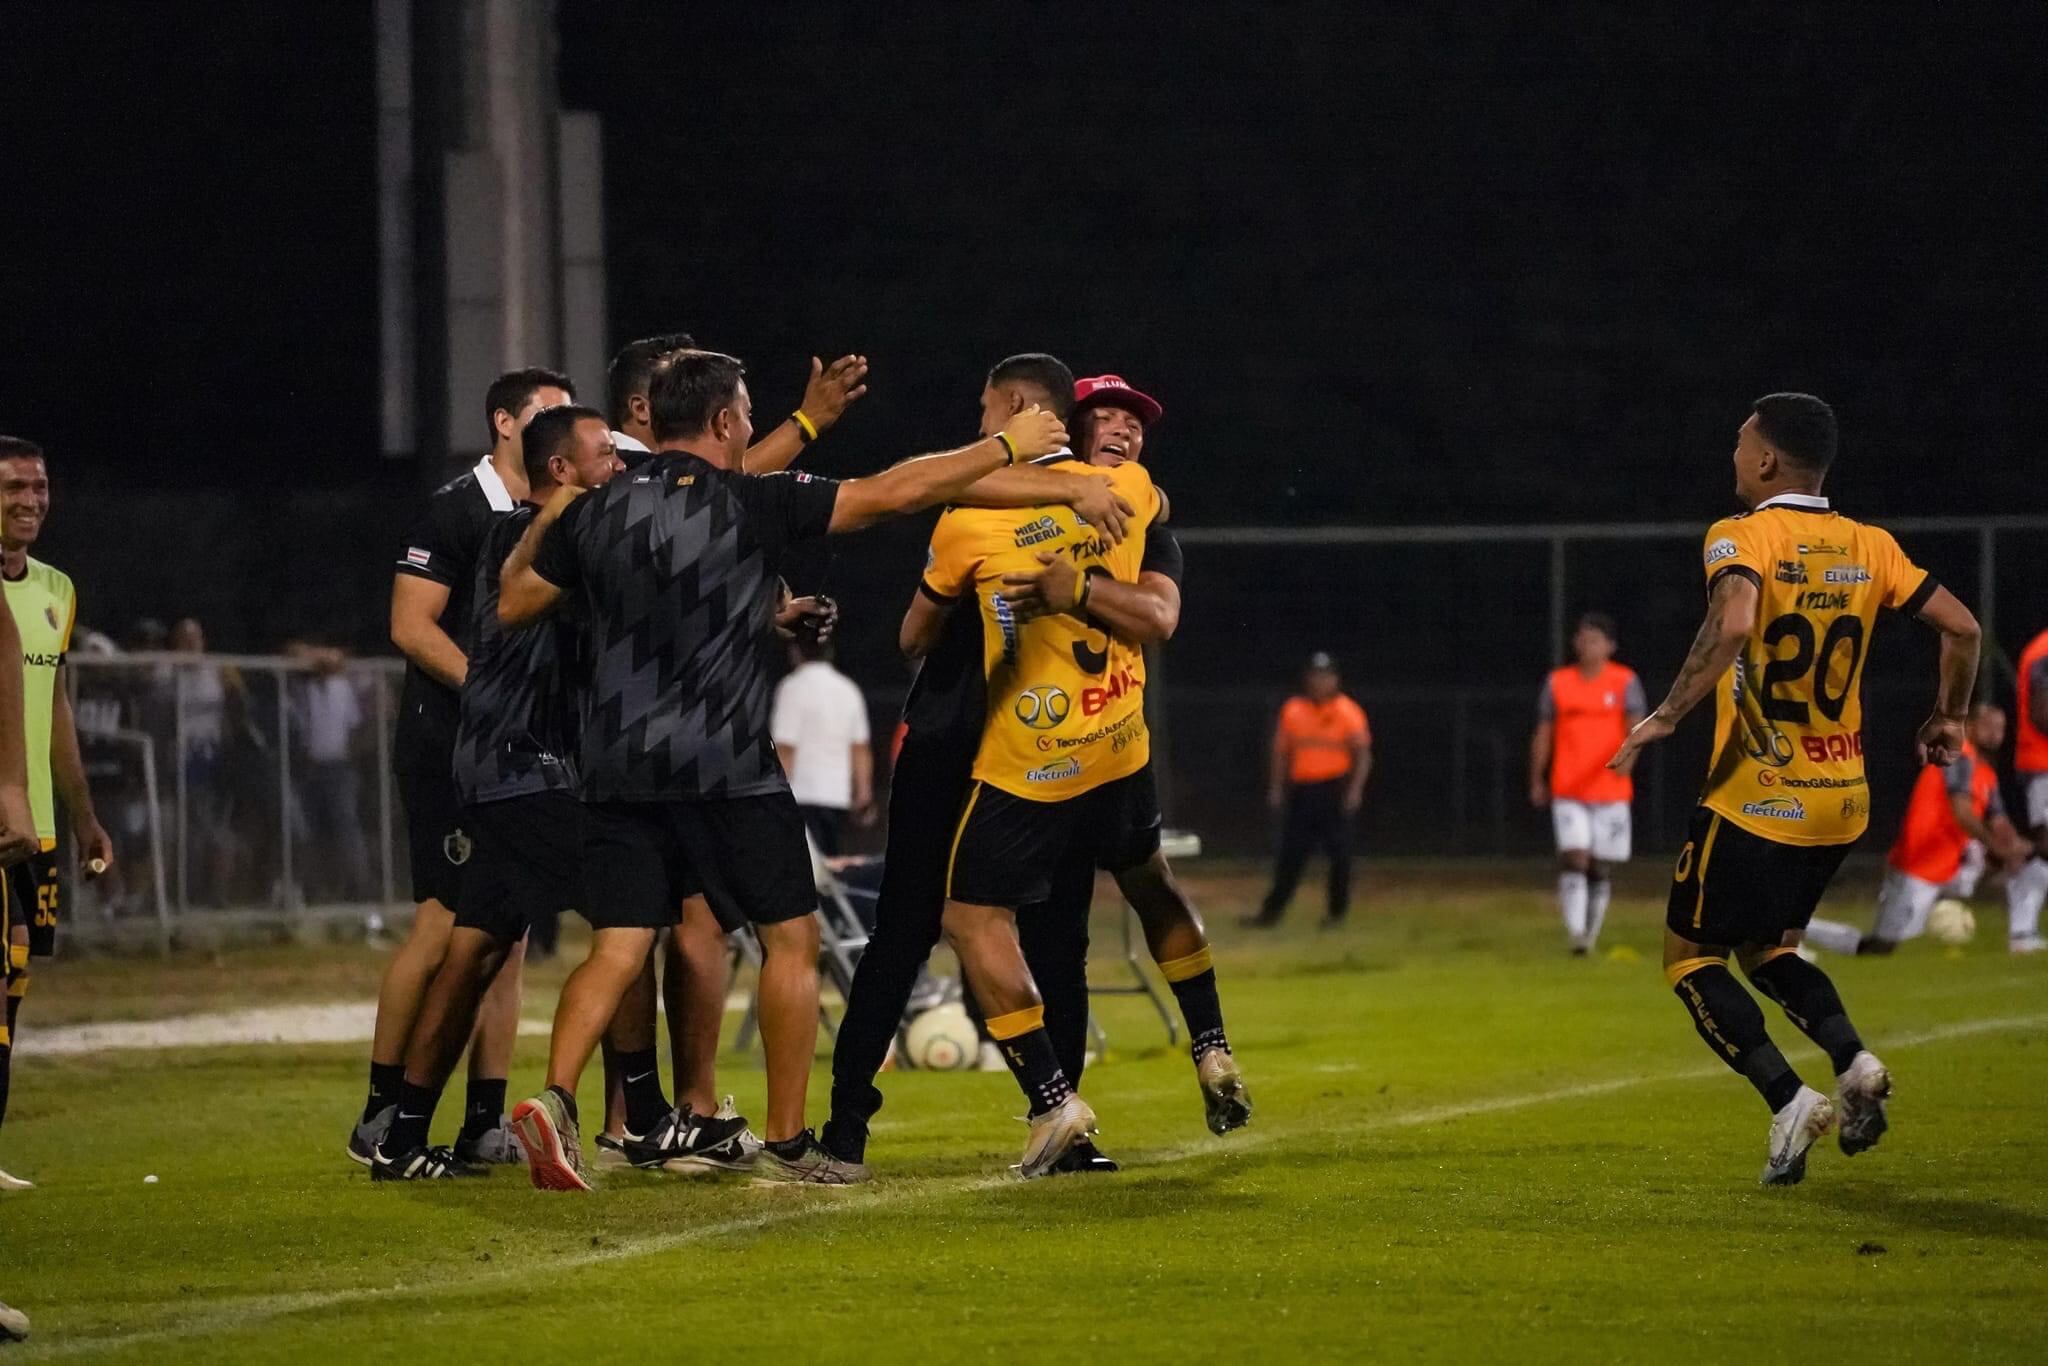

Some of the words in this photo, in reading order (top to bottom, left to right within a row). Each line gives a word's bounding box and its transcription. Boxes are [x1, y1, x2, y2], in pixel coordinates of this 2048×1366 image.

[1014, 525, 1066, 548] LIBERIA
[1761, 613, 1864, 724] 20
[1026, 764, 1080, 781] Electrolit
[1742, 800, 1806, 820] Electrolit
[1681, 977, 1741, 1058] LIBERIA
